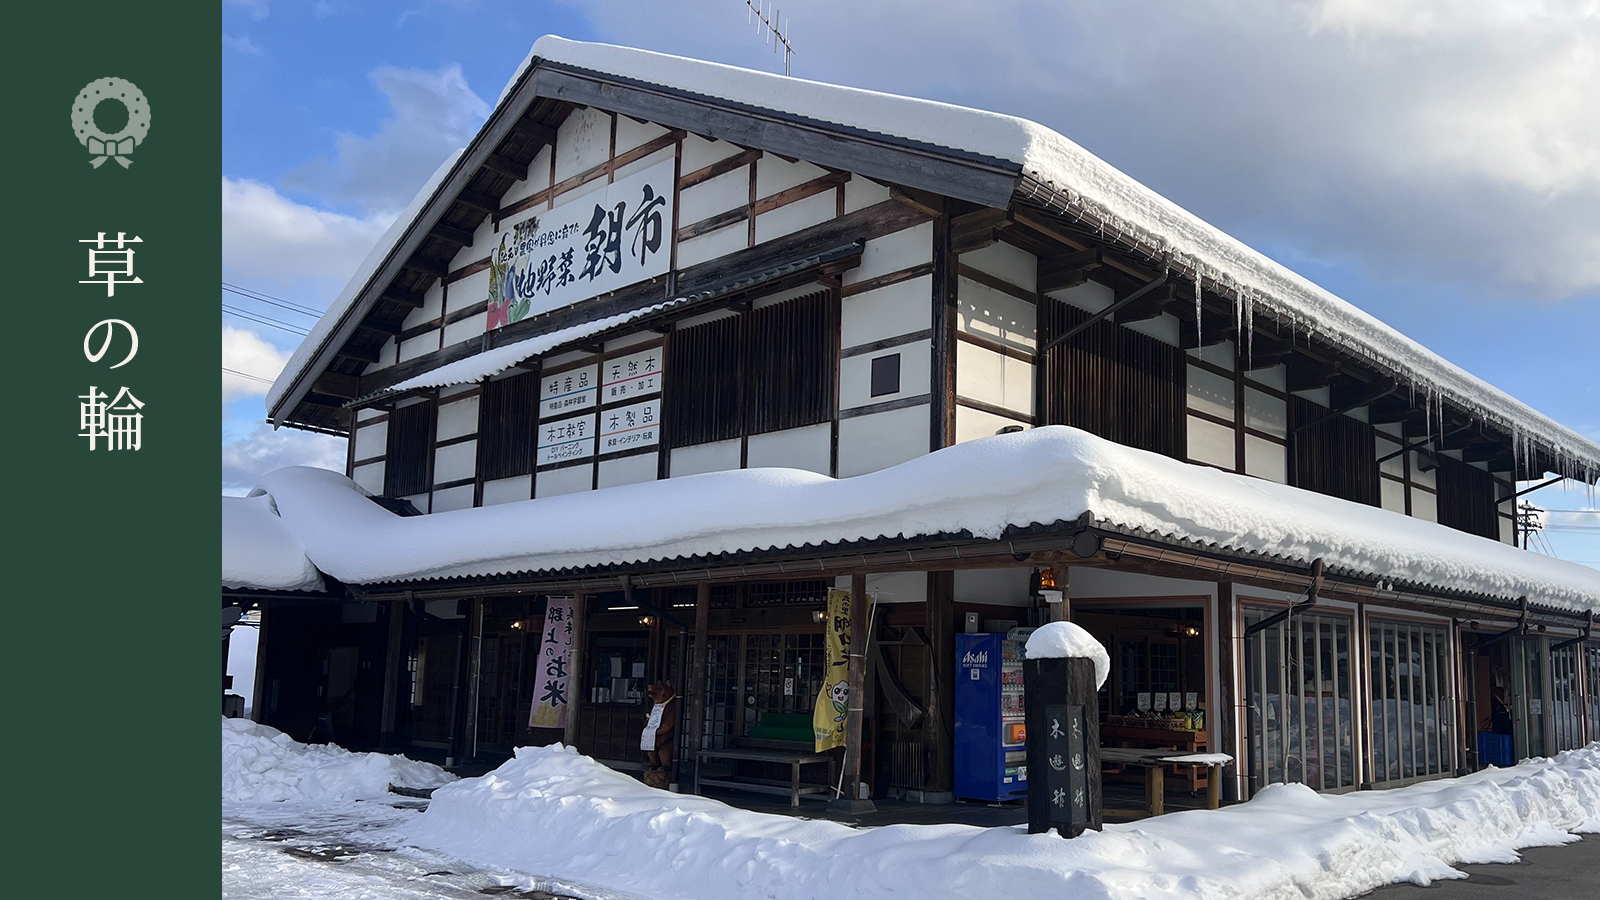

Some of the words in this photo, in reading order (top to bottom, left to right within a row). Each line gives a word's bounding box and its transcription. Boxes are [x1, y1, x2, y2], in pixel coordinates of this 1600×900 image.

[515, 247, 575, 299] 地野菜
[579, 184, 666, 282] 朝市
[612, 355, 655, 380] 天然木
[548, 372, 588, 395] 特産品
[610, 406, 653, 430] 木製品
[547, 420, 586, 442] 木工教室
[962, 650, 988, 664] Asahi
